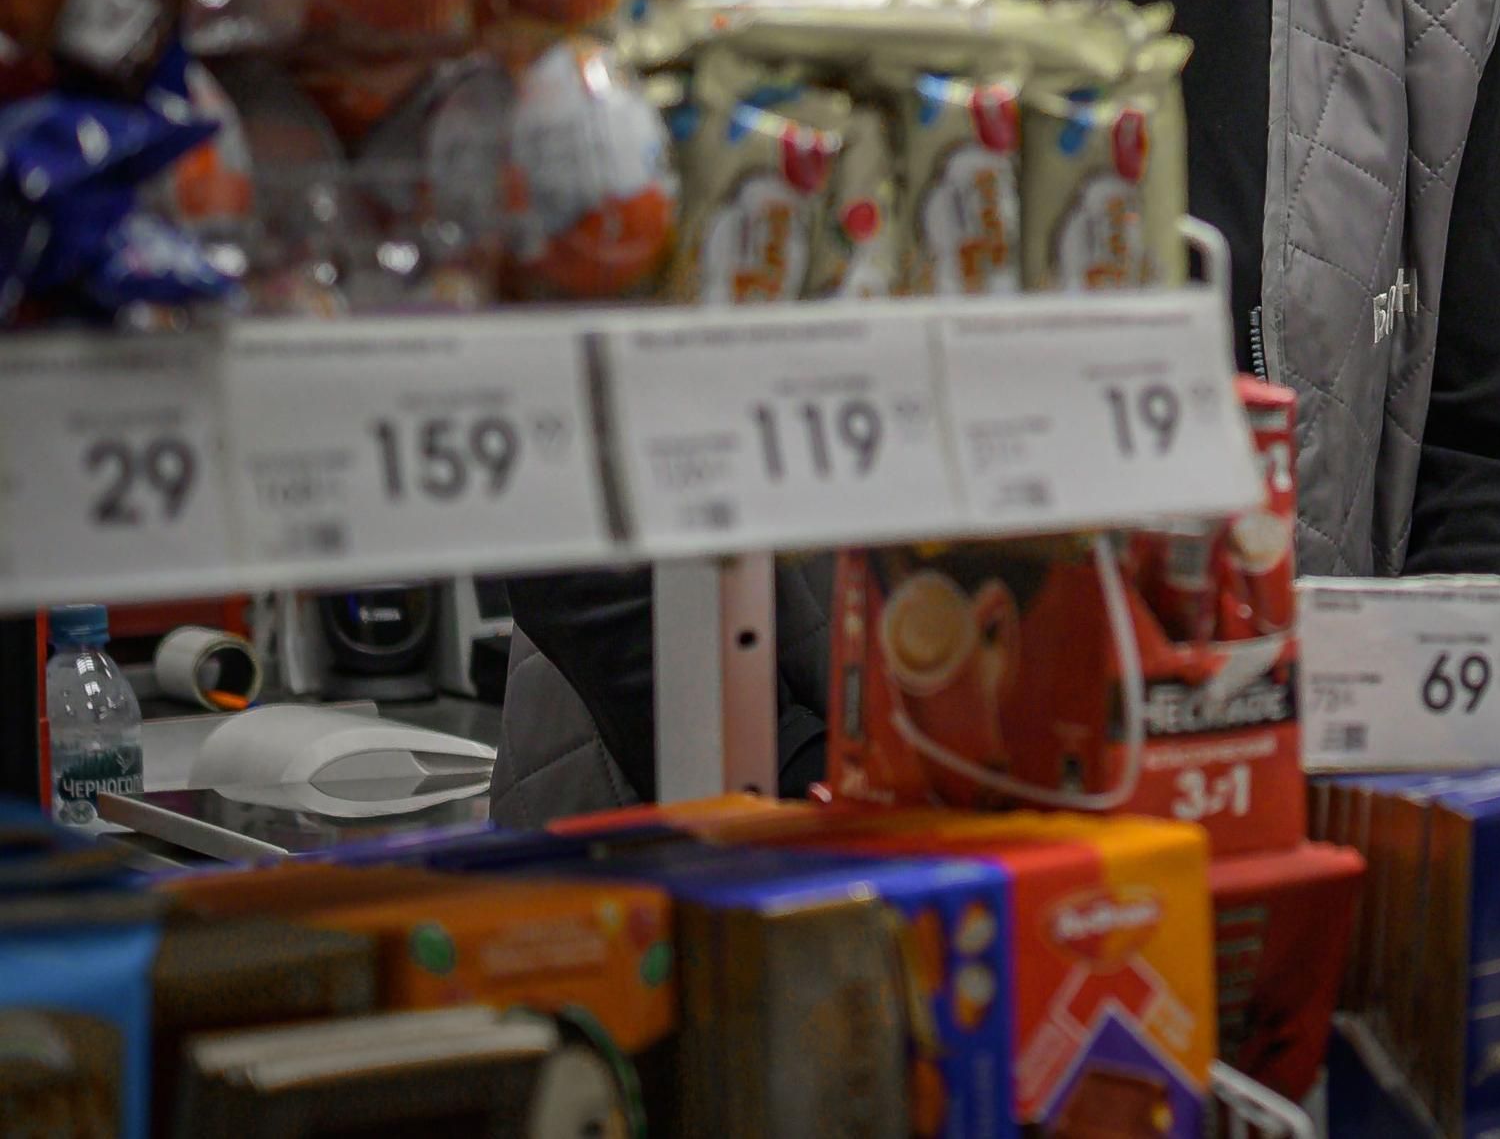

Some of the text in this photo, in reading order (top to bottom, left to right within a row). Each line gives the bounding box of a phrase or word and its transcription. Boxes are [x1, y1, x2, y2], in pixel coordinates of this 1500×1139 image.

[372, 414, 519, 503] 159
[753, 399, 883, 483] 119
[1103, 382, 1179, 458] 19
[88, 435, 196, 527] 29
[1422, 651, 1492, 715] 69
